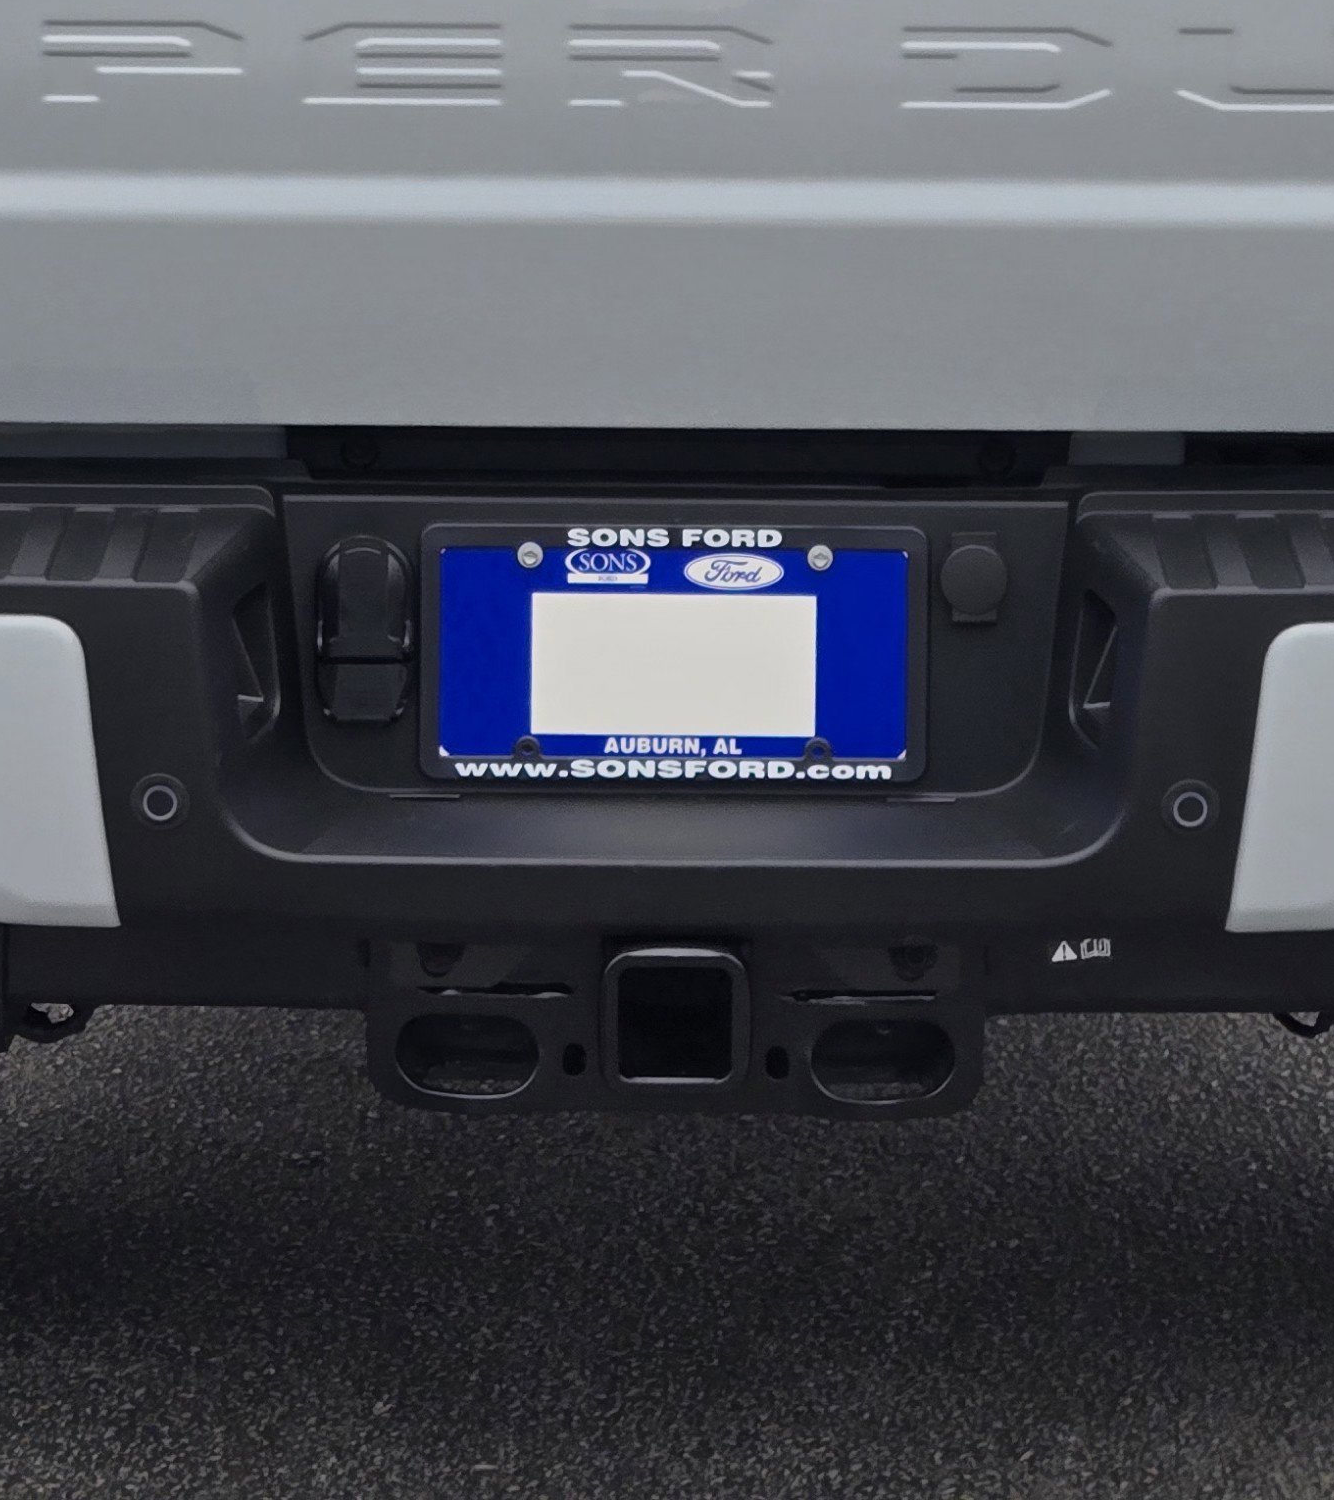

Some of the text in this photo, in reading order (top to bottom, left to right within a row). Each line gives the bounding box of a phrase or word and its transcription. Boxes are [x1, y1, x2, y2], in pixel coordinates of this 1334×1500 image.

[567, 528, 783, 547] SONS FORD
[578, 553, 638, 572] SONS
[704, 559, 763, 583] Ford
[604, 737, 742, 757] AUBURN, AL
[455, 759, 893, 780] www.SONSFORD.com
